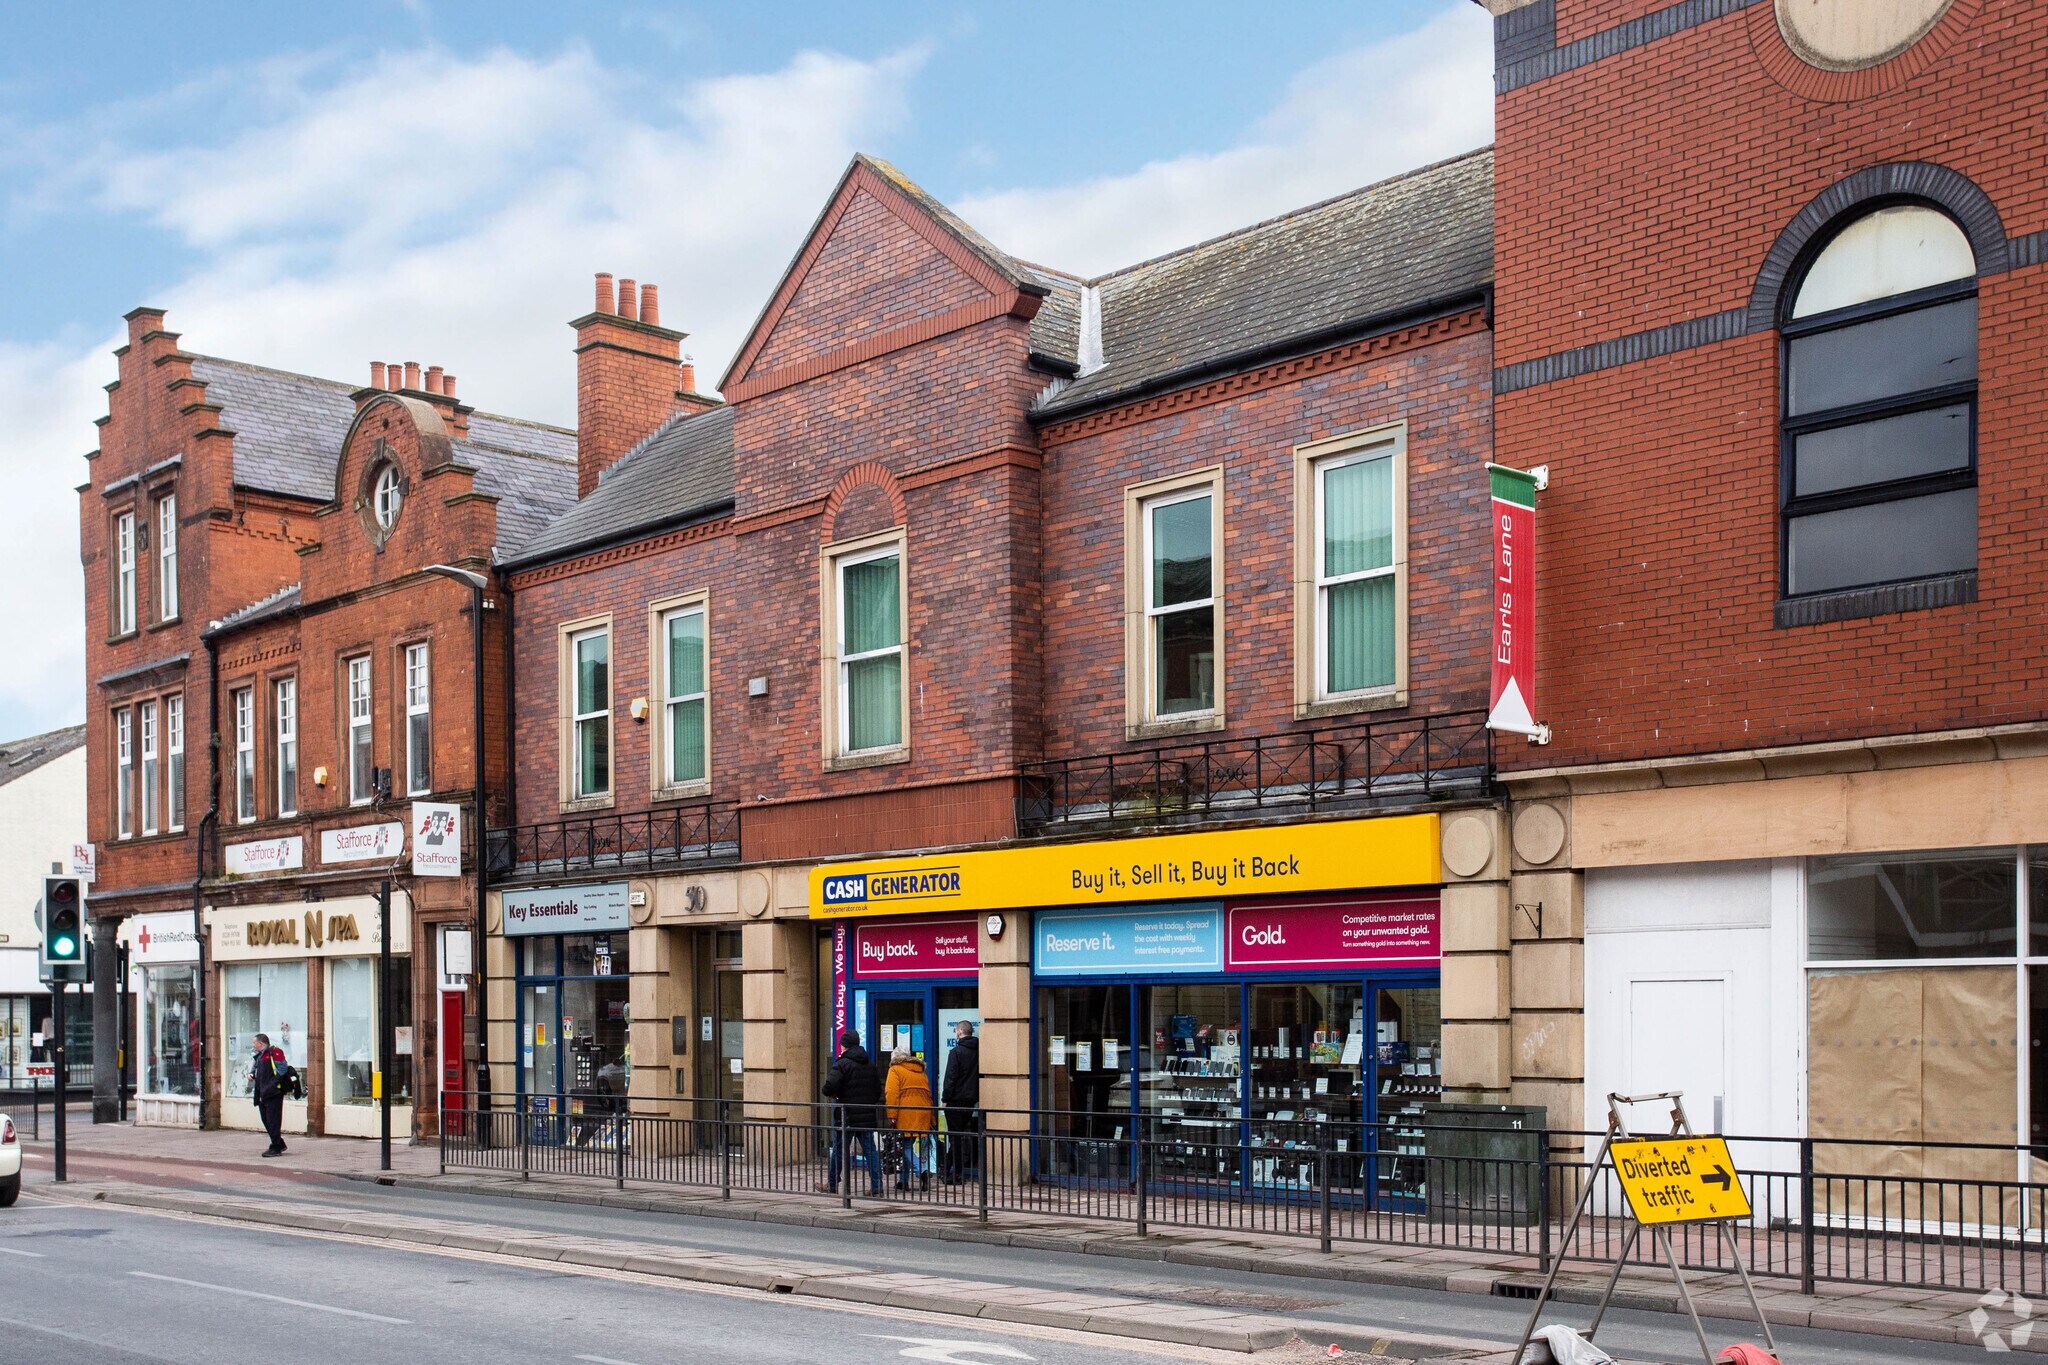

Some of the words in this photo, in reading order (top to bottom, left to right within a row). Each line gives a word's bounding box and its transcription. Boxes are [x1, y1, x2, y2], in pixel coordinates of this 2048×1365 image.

[1499, 514, 1512, 584] Lane
[1497, 592, 1512, 665] Earls
[336, 831, 372, 850] Stafforce
[244, 845, 275, 862] Stafforce
[416, 852, 458, 864] Stafforce
[1072, 869, 1104, 894] Buy
[1109, 866, 1126, 889] it,
[1131, 863, 1163, 886] Sell
[1168, 862, 1186, 885] it,
[1192, 861, 1227, 887] Buy
[1233, 857, 1246, 879] it
[1252, 854, 1300, 878] Back
[826, 879, 864, 900] CASH
[871, 872, 961, 896] GENERATOR
[509, 904, 527, 922] Key
[529, 900, 579, 917] Essentials
[822, 904, 868, 915] cashgenerator.co.uk
[1342, 914, 1387, 926] Competitive
[1388, 912, 1415, 922] market
[1416, 912, 1436, 921] rates
[247, 919, 299, 946] ROYAL
[304, 910, 324, 949] N
[326, 913, 360, 942] SPA
[1135, 922, 1158, 931] Reserve
[1159, 922, 1164, 930] it
[1164, 922, 1185, 932] today.
[1186, 920, 1210, 931] Spread
[1242, 924, 1286, 946] Gold.
[1342, 929, 1352, 937] on
[1353, 929, 1371, 939] your
[1371, 926, 1409, 936] unwanted
[1410, 925, 1430, 937] gold.
[835, 925, 846, 952] buy.
[935, 936, 944, 944] Sell
[944, 938, 955, 946] your
[956, 936, 968, 944] stuff,
[1046, 934, 1100, 952] Reserve
[1102, 932, 1115, 950] it.
[1135, 934, 1145, 943] the
[1146, 935, 1159, 943] cost
[1159, 933, 1173, 942] with
[1173, 932, 1196, 943] weekly
[1353, 940, 1375, 948] something
[1376, 940, 1386, 948] gold
[1395, 939, 1419, 947] something
[863, 942, 885, 962] Buy
[887, 940, 918, 957] back.
[935, 947, 945, 957] buy
[950, 947, 963, 955] back
[1135, 946, 1158, 955] interest
[1158, 946, 1170, 954] free
[1171, 946, 1205, 956] payments.
[835, 953, 844, 975] We
[836, 981, 846, 1008] buy.
[836, 1009, 844, 1031] We
[859, 1021, 867, 1043] We
[1512, 1120, 1522, 1130] 11
[1621, 1155, 1692, 1179] Diverted
[1642, 1184, 1695, 1208] traffic
